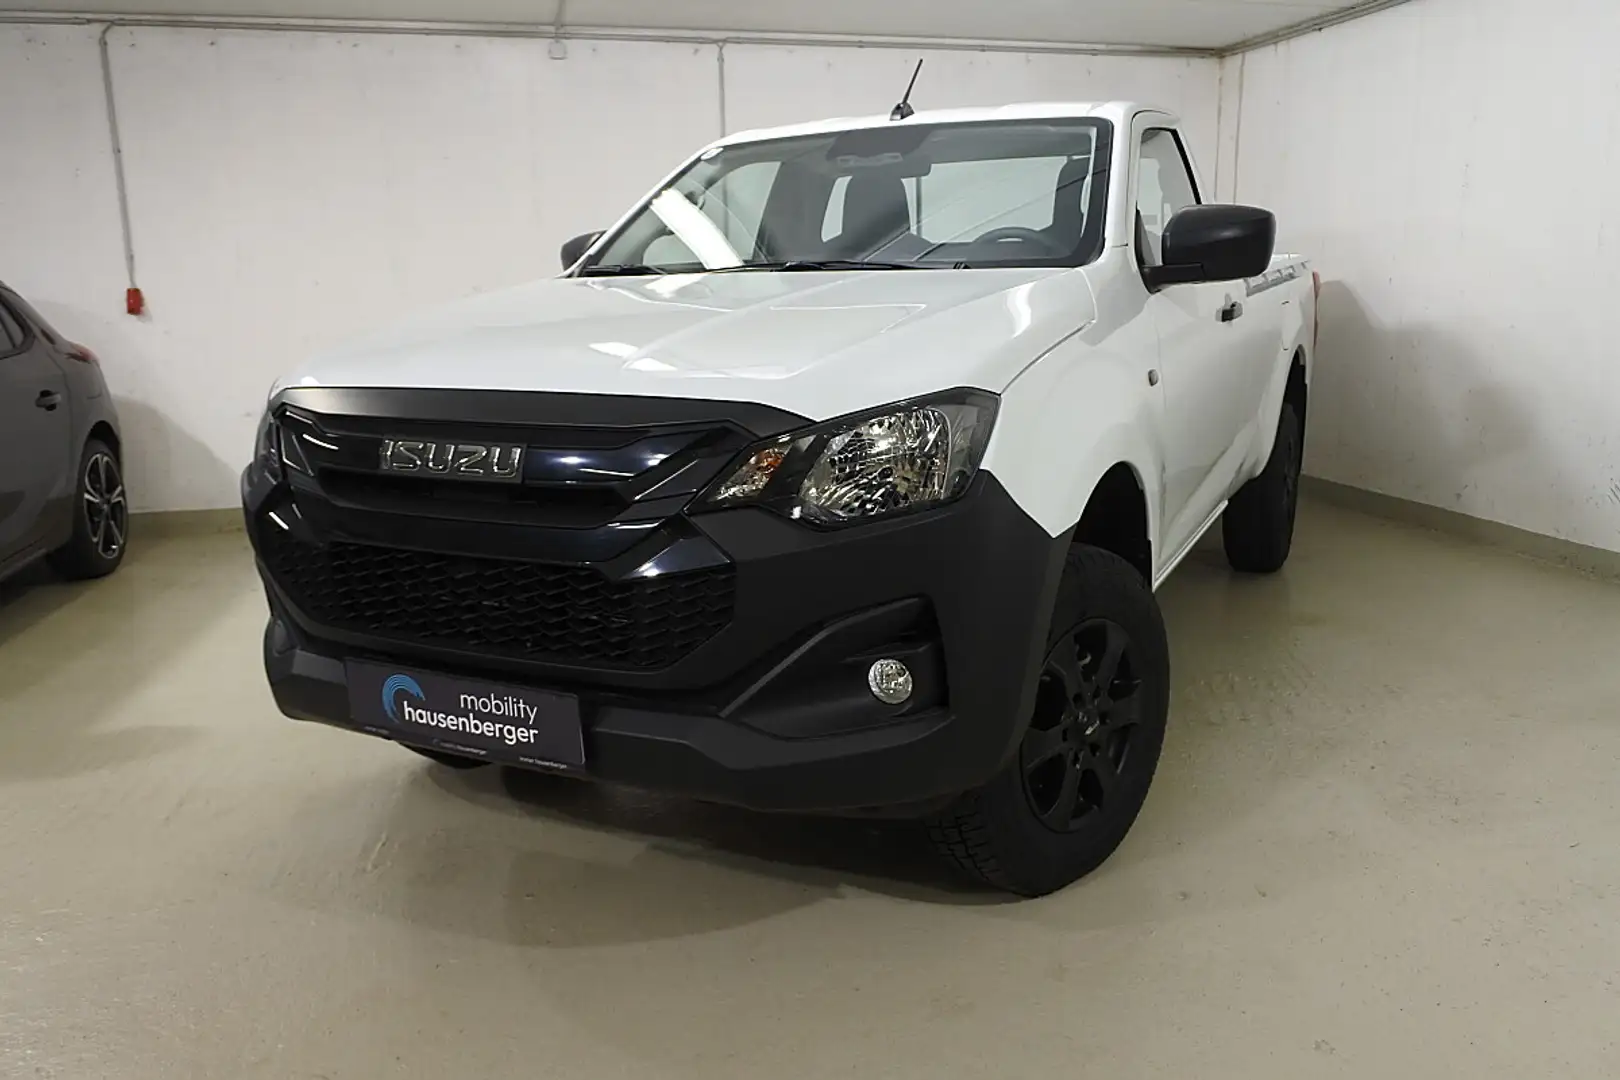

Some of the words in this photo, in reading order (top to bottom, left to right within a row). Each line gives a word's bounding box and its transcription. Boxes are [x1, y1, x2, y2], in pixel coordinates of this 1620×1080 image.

[380, 439, 521, 477] ISUZU
[403, 700, 539, 745] hausenberger
[460, 693, 538, 724] mobility
